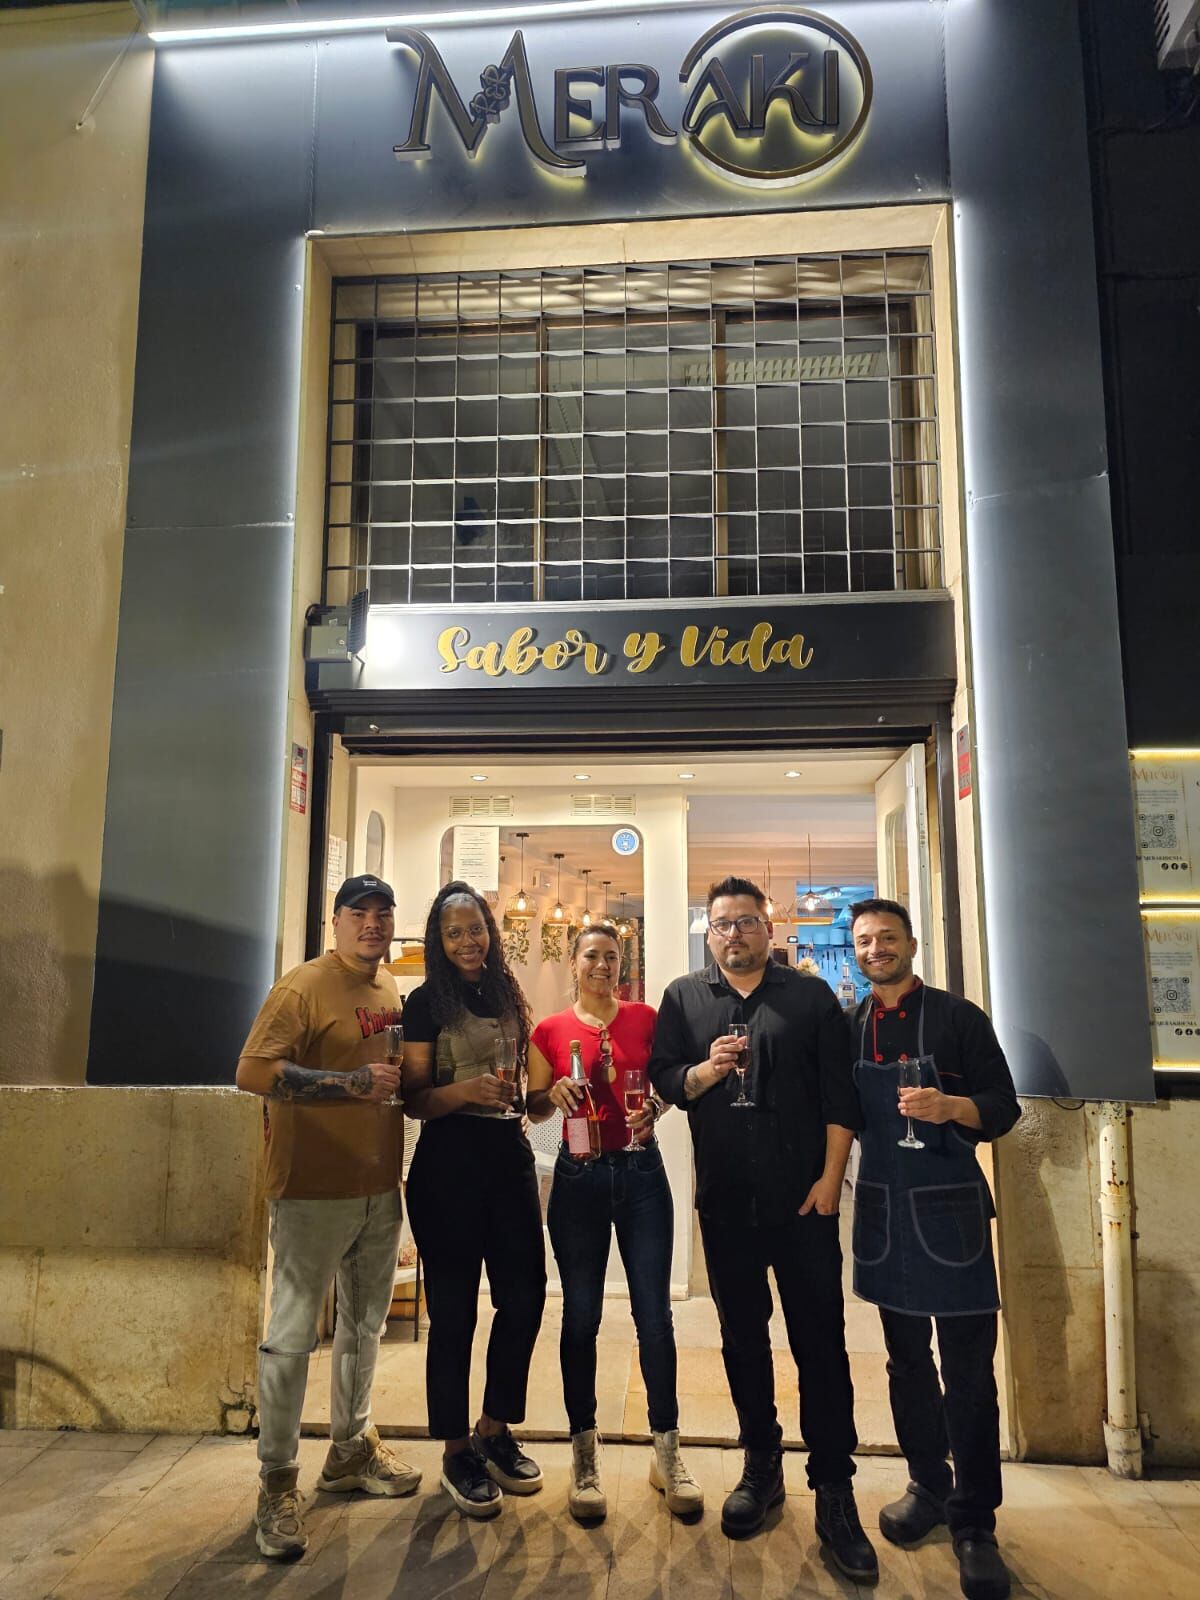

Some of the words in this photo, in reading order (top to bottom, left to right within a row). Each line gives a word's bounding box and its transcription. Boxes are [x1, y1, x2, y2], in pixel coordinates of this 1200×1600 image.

[386, 29, 840, 177] MERAKI
[437, 625, 608, 676] Sabor
[624, 632, 666, 673] y
[680, 622, 814, 673] Vida
